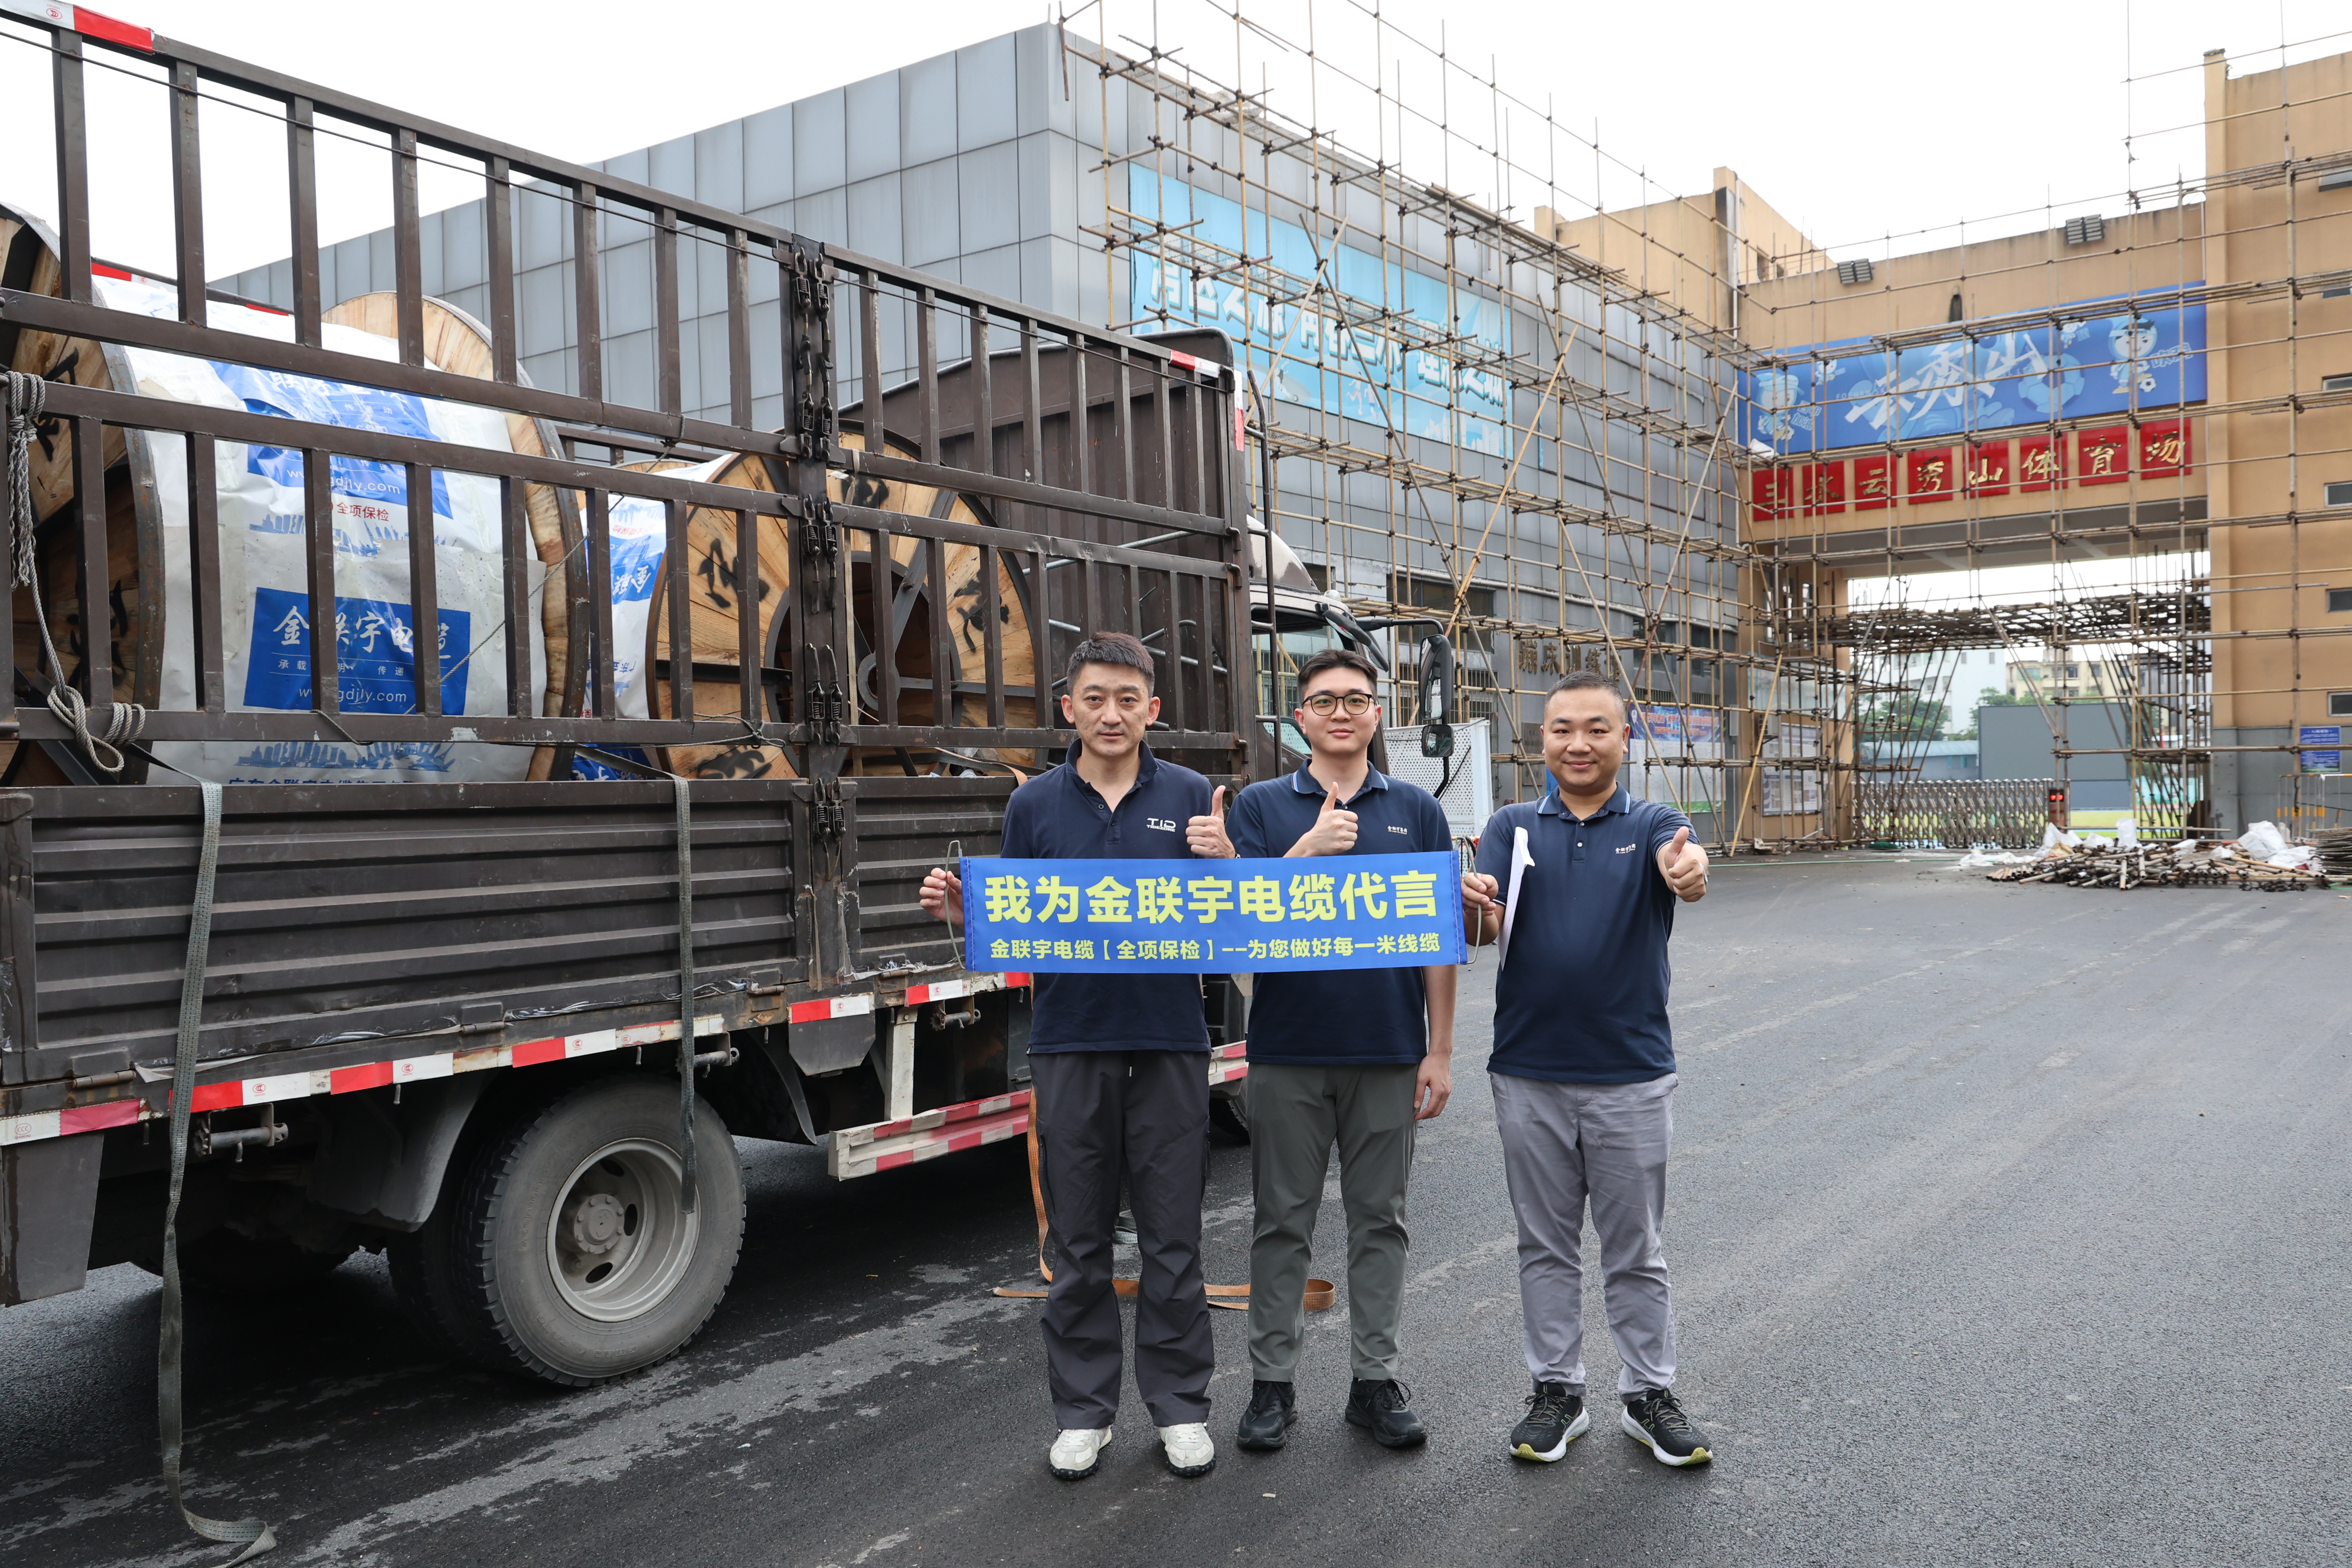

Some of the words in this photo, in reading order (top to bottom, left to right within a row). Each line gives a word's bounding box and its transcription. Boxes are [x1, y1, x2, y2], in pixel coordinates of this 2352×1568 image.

[1844, 332, 2048, 430] 云秀山
[287, 468, 400, 495] wgdjly.com
[1758, 431, 2186, 507] 三水云秀山体育场
[337, 501, 390, 522] 全项保检
[299, 687, 407, 703] wgdjly.com
[1146, 824, 1176, 832] TIDEZONE
[985, 870, 1437, 925] 我为金联宇电缆代言
